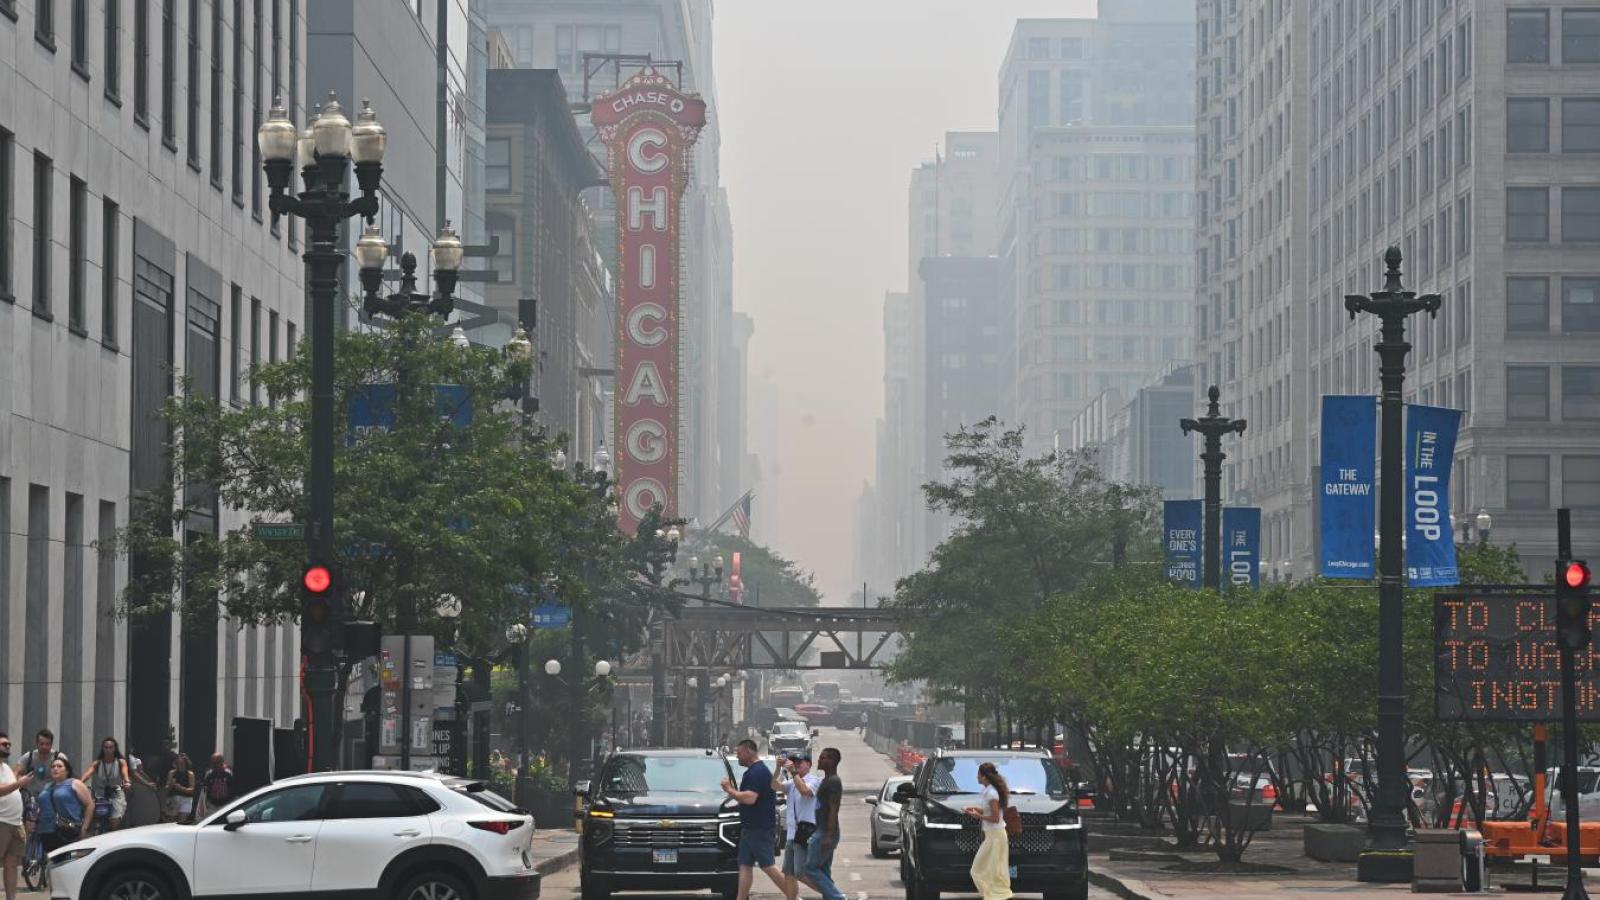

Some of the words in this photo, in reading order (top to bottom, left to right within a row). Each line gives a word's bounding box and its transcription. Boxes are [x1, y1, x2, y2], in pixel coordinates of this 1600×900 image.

[612, 92, 668, 113] CHASE
[626, 128, 669, 521] CHICAGO
[1422, 431, 1437, 443] IN
[1420, 447, 1435, 469] THE
[1339, 469, 1357, 481] THE
[1325, 483, 1371, 495] GATEWAY
[1414, 475, 1441, 541] LOOP
[1169, 529, 1197, 539] EVERY
[1235, 530, 1247, 547] THE
[1169, 540, 1197, 551] ONE'S
[1443, 601, 1489, 632] TO
[1444, 640, 1489, 671] TO
